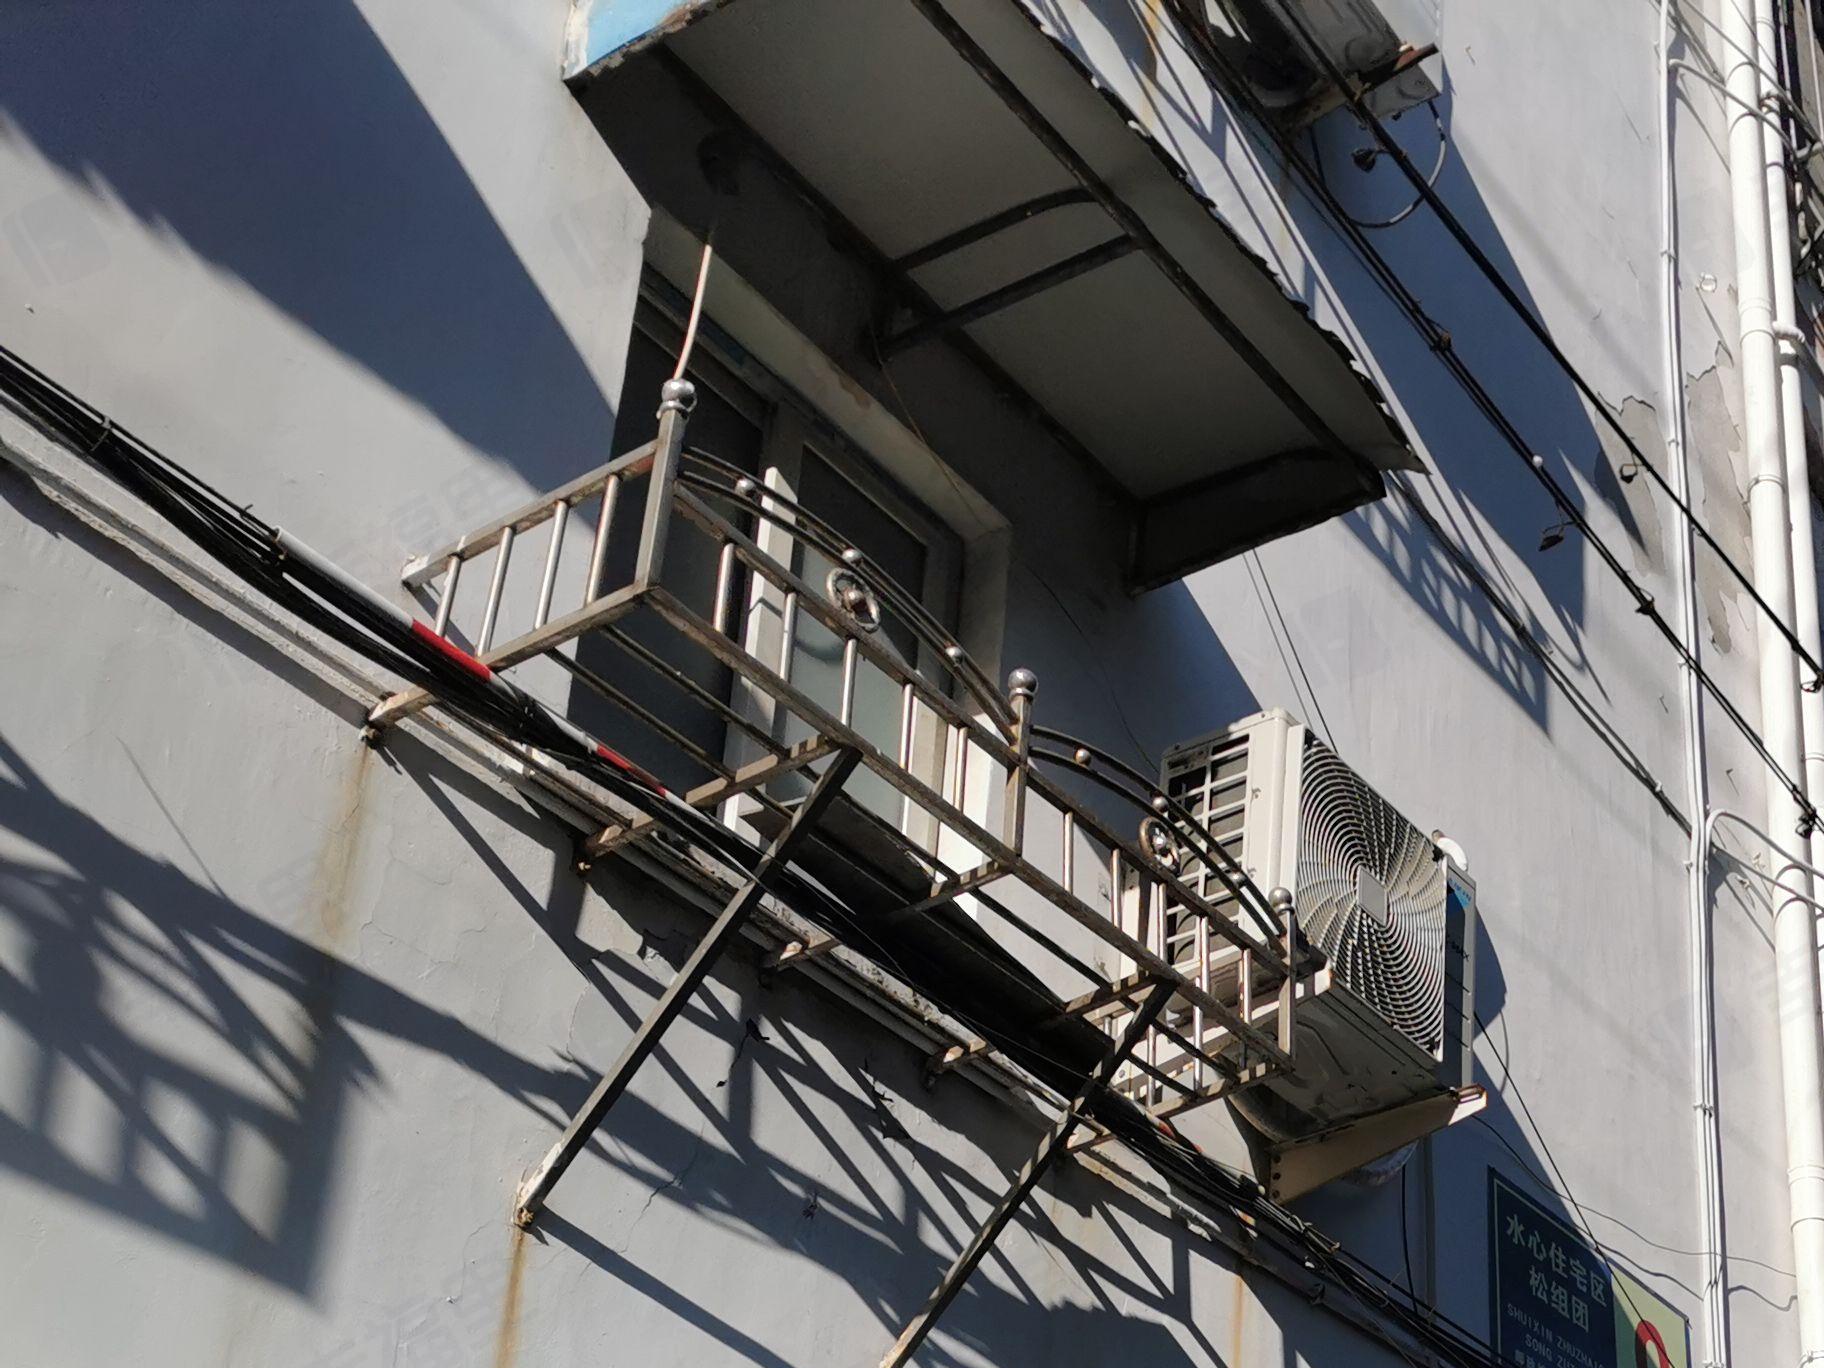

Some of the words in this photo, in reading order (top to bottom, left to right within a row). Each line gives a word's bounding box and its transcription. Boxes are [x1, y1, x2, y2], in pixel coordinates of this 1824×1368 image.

[1507, 1214, 1607, 1307] 水心住宅区
